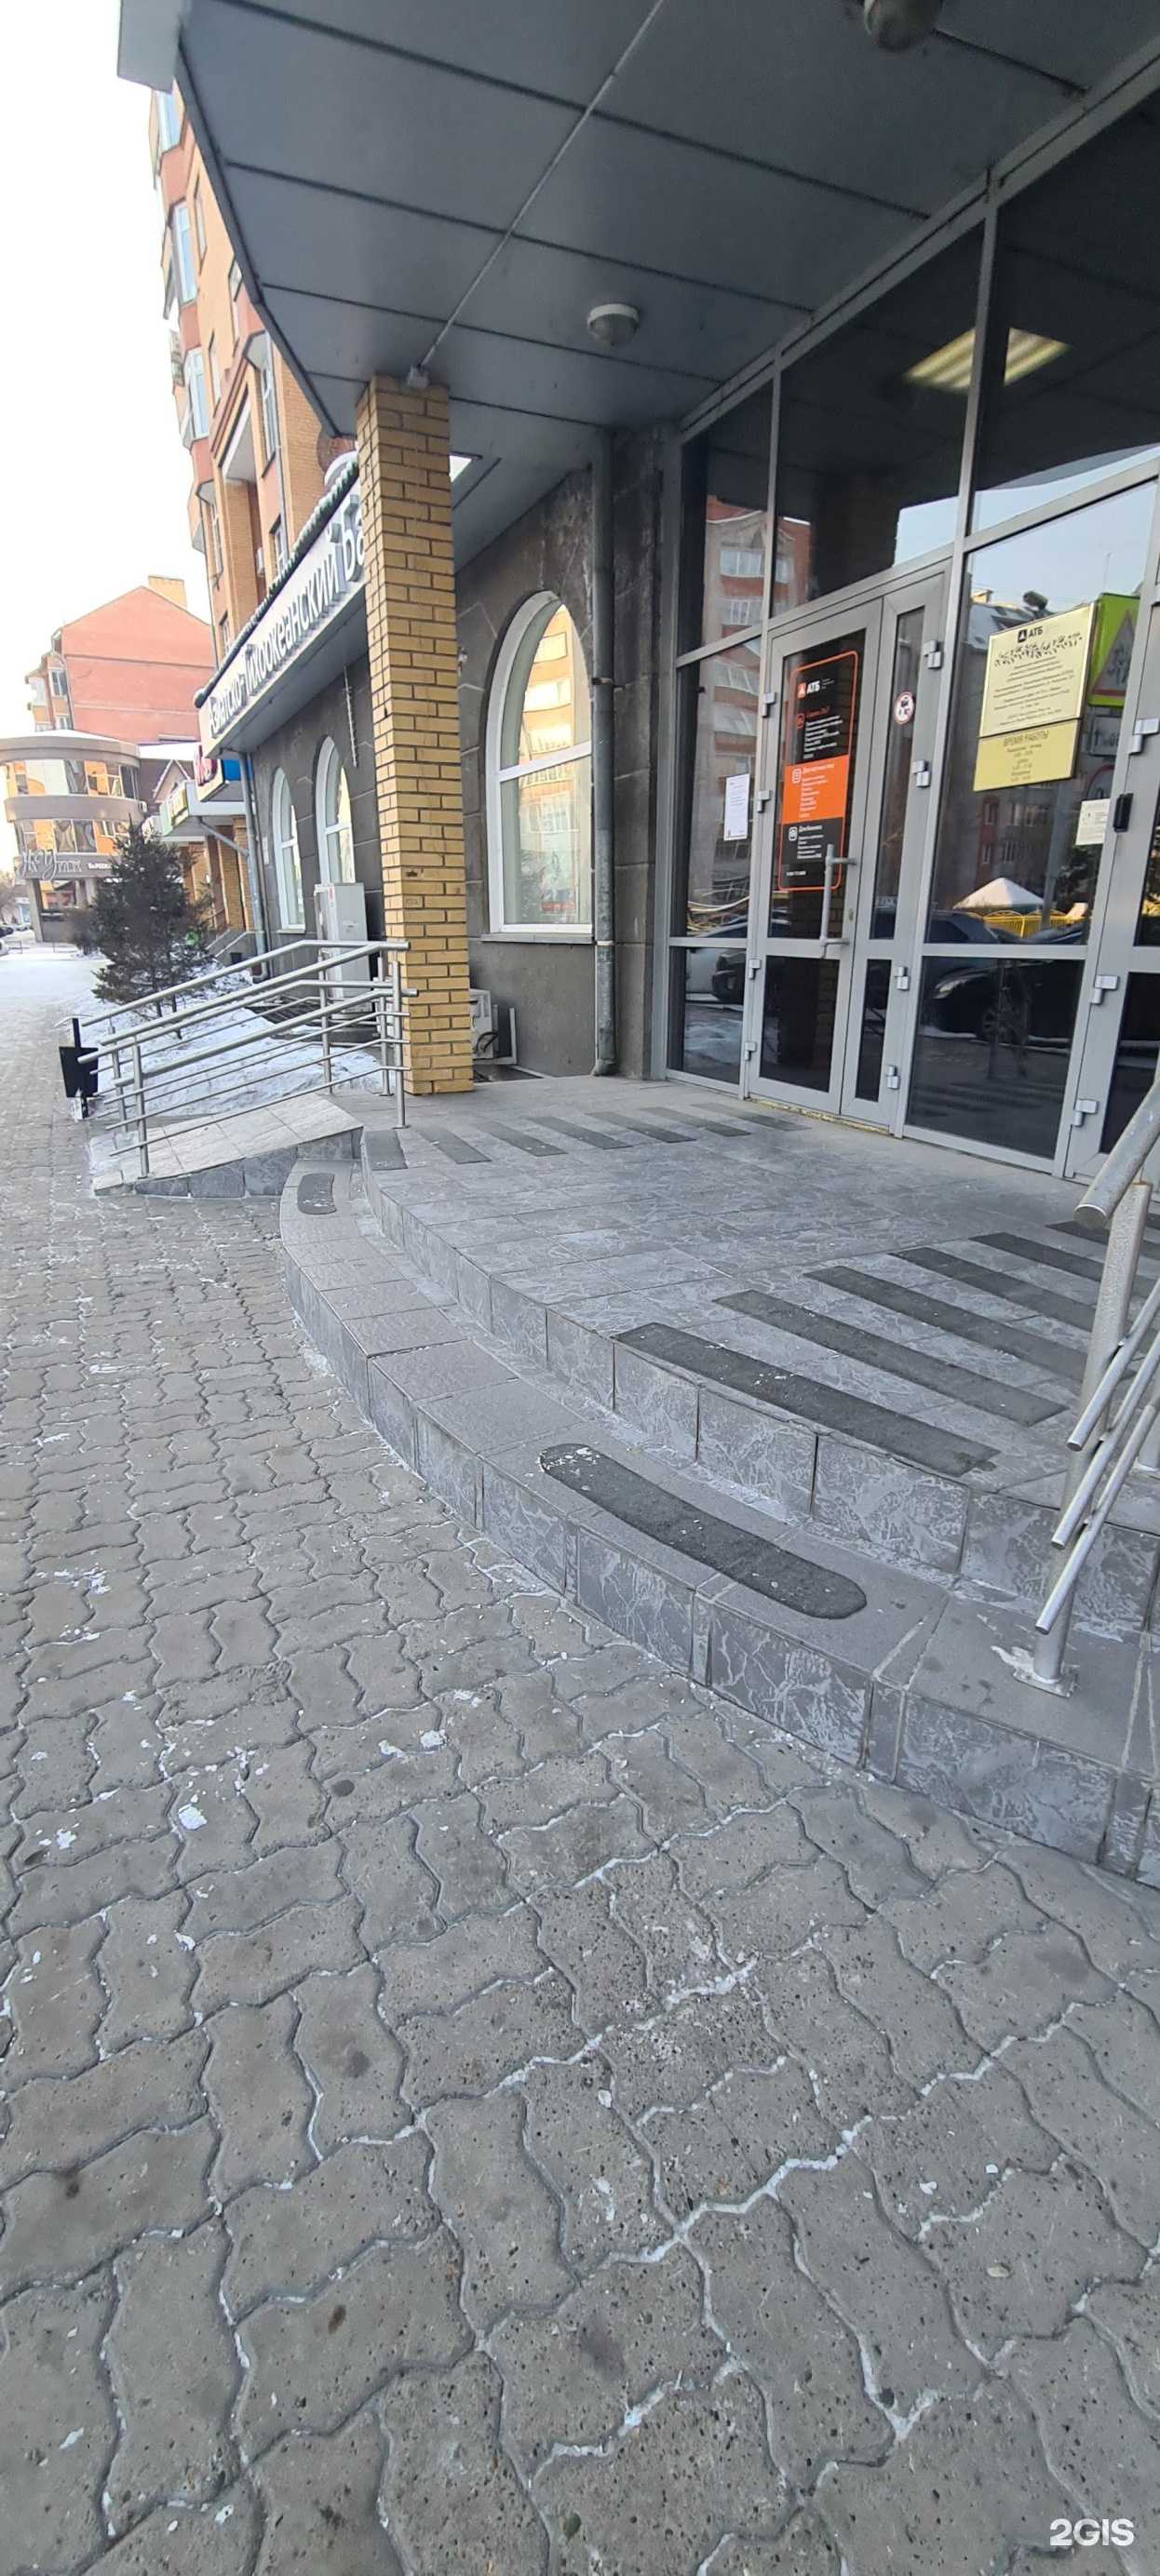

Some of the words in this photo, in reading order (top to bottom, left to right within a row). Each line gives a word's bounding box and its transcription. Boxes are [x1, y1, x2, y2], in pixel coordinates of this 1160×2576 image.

[209, 523, 341, 737] Азиатско-Тихоокеанский
[1028, 626, 1044, 637] АТБ
[806, 680, 820, 694] АТБ
